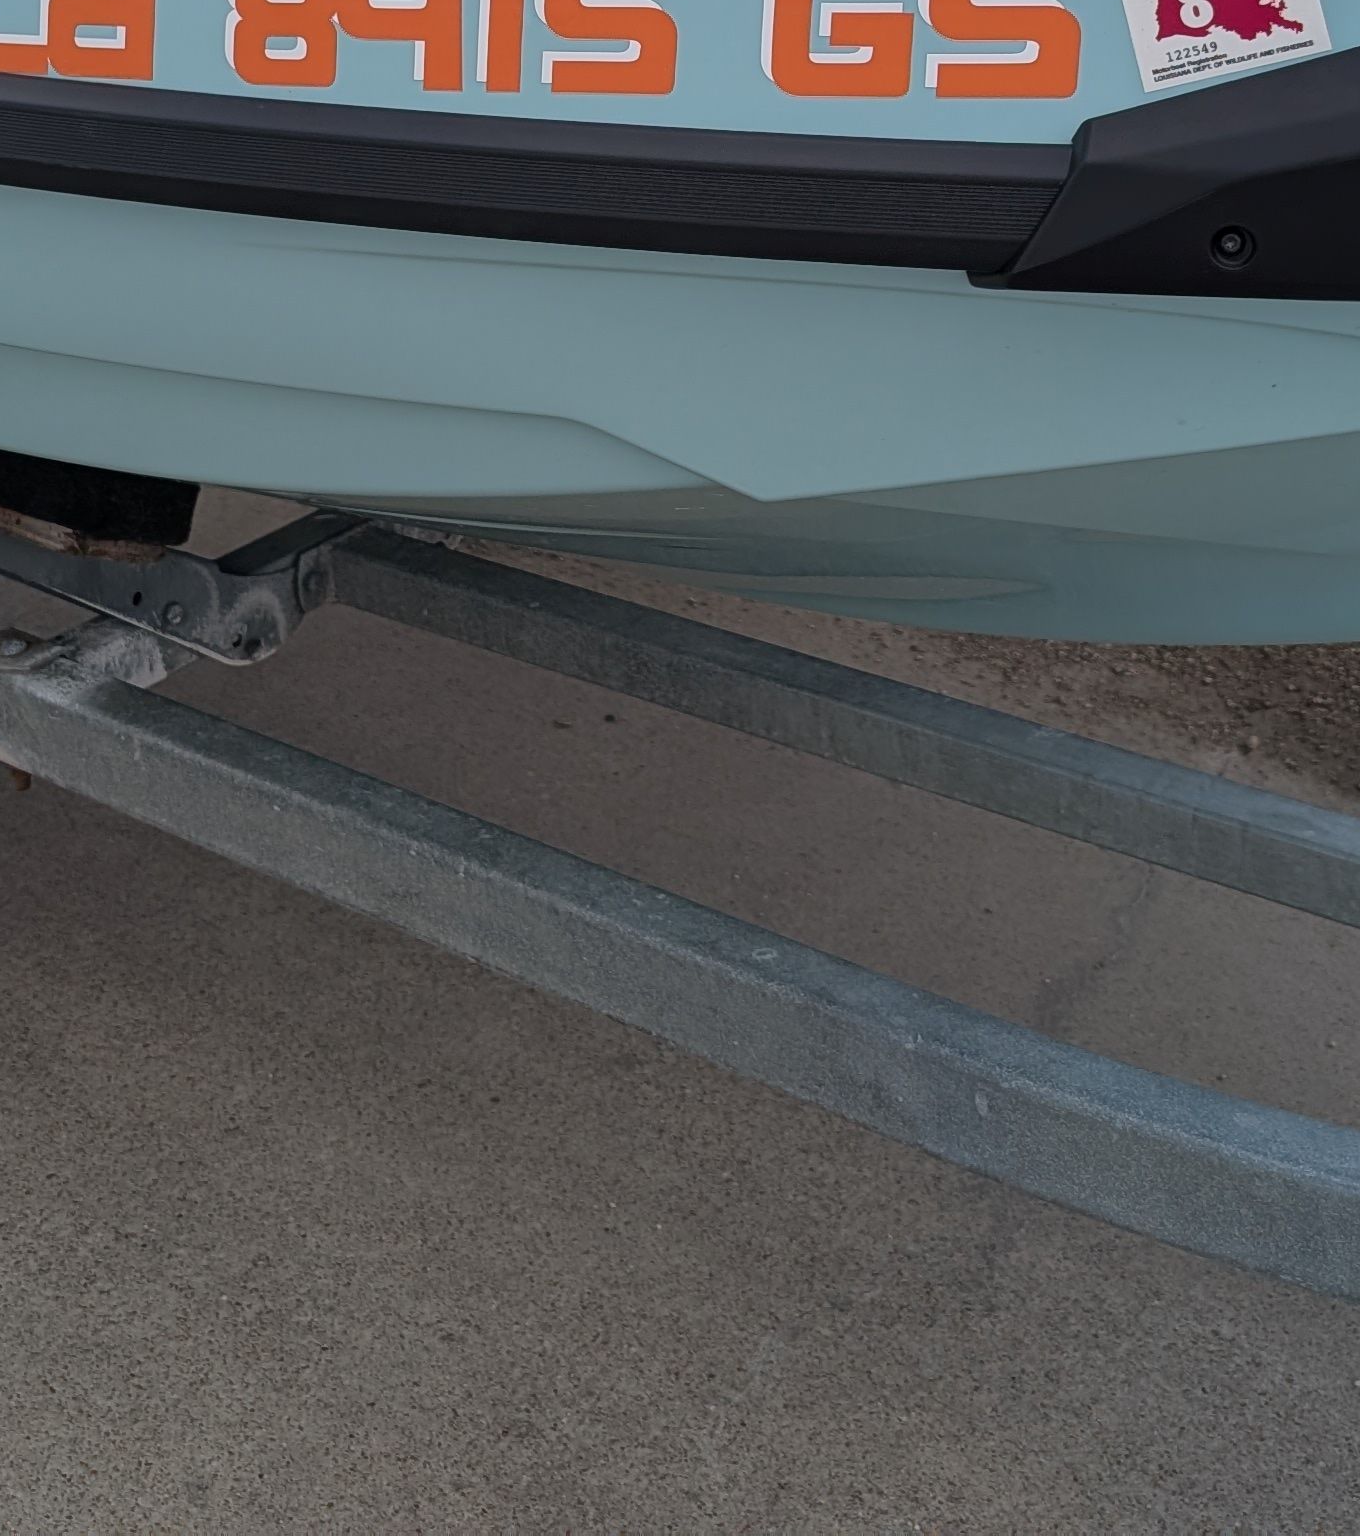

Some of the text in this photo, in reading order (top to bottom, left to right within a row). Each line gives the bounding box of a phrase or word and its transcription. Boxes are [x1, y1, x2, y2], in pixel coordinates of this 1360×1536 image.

[1154, 68, 1192, 82] LOUISIANA
[1225, 52, 1258, 65] WILDLIFE
[1260, 49, 1274, 58] AND
[1276, 39, 1314, 53] FISHERIES
[1166, 41, 1218, 63] 122549
